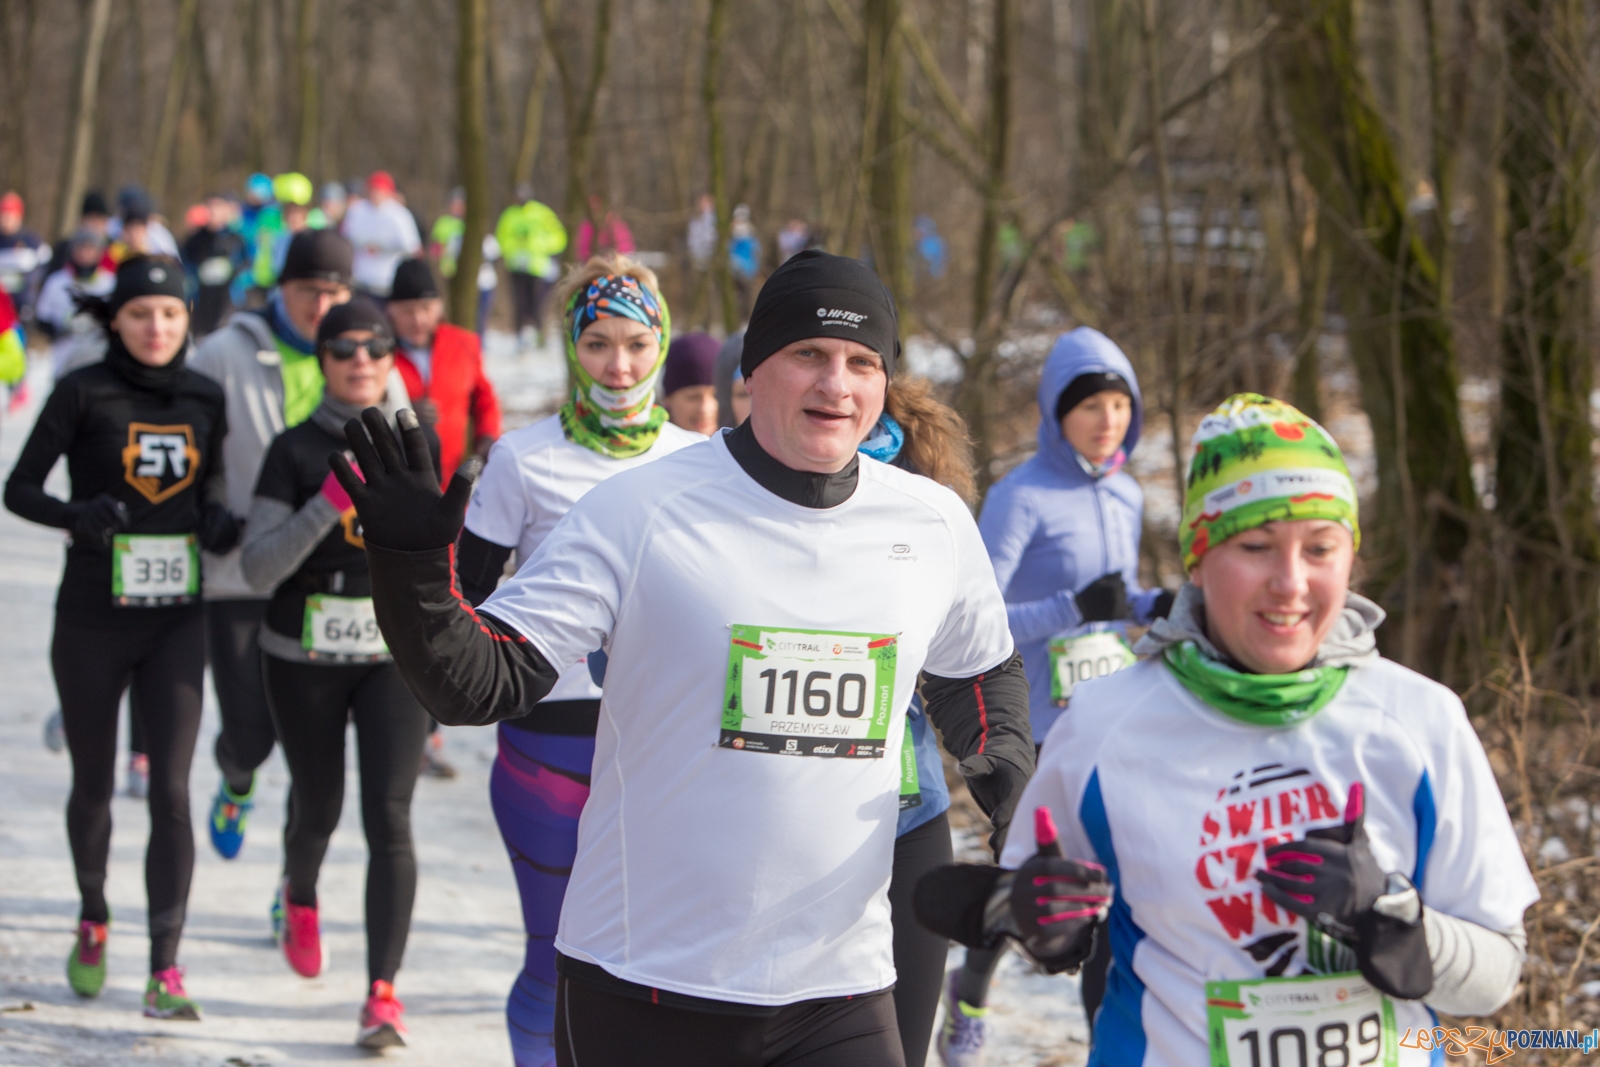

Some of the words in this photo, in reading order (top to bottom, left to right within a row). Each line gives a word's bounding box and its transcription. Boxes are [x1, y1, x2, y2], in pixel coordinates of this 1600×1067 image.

[137, 433, 187, 478] SR
[134, 557, 183, 584] 336
[324, 617, 379, 642] 649
[759, 668, 867, 719] 1160
[876, 684, 890, 726] Poznań
[770, 720, 851, 736] PRZEMYSŁAW
[903, 749, 914, 783] Poznań
[1238, 1010, 1381, 1067] 1089
